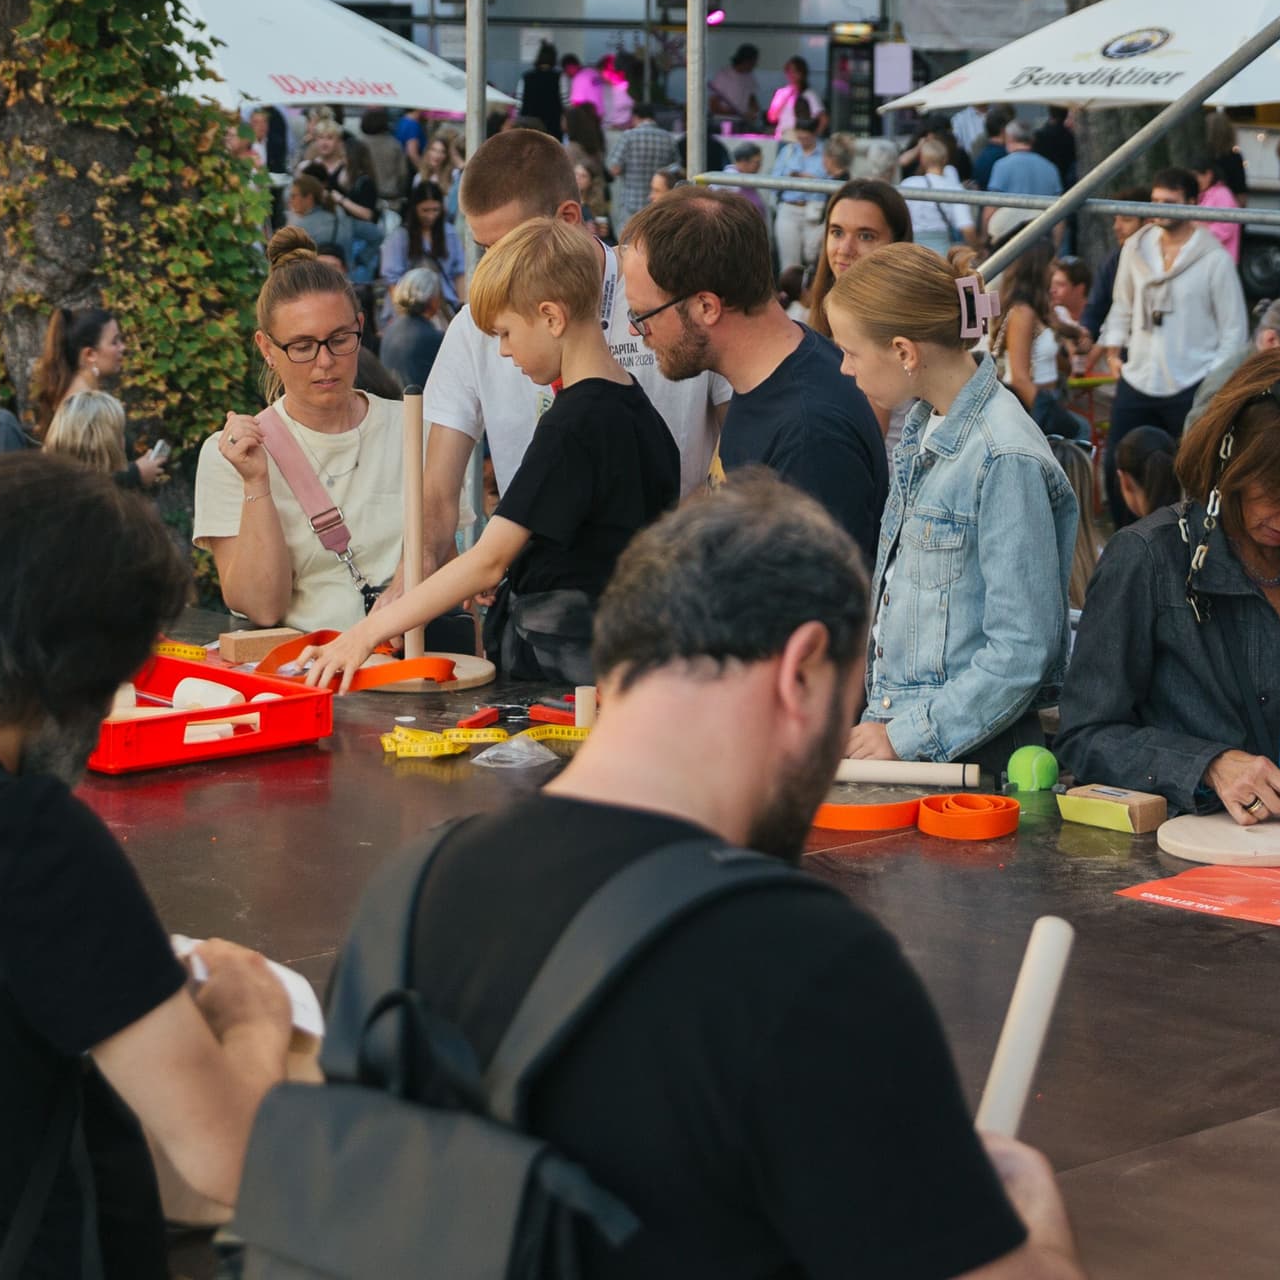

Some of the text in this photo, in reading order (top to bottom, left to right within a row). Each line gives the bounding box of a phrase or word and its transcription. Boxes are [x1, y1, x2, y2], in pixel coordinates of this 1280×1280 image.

[1006, 66, 1185, 91] Benediktiner
[609, 342, 639, 355] CAPITAL
[635, 353, 654, 366] 2026
